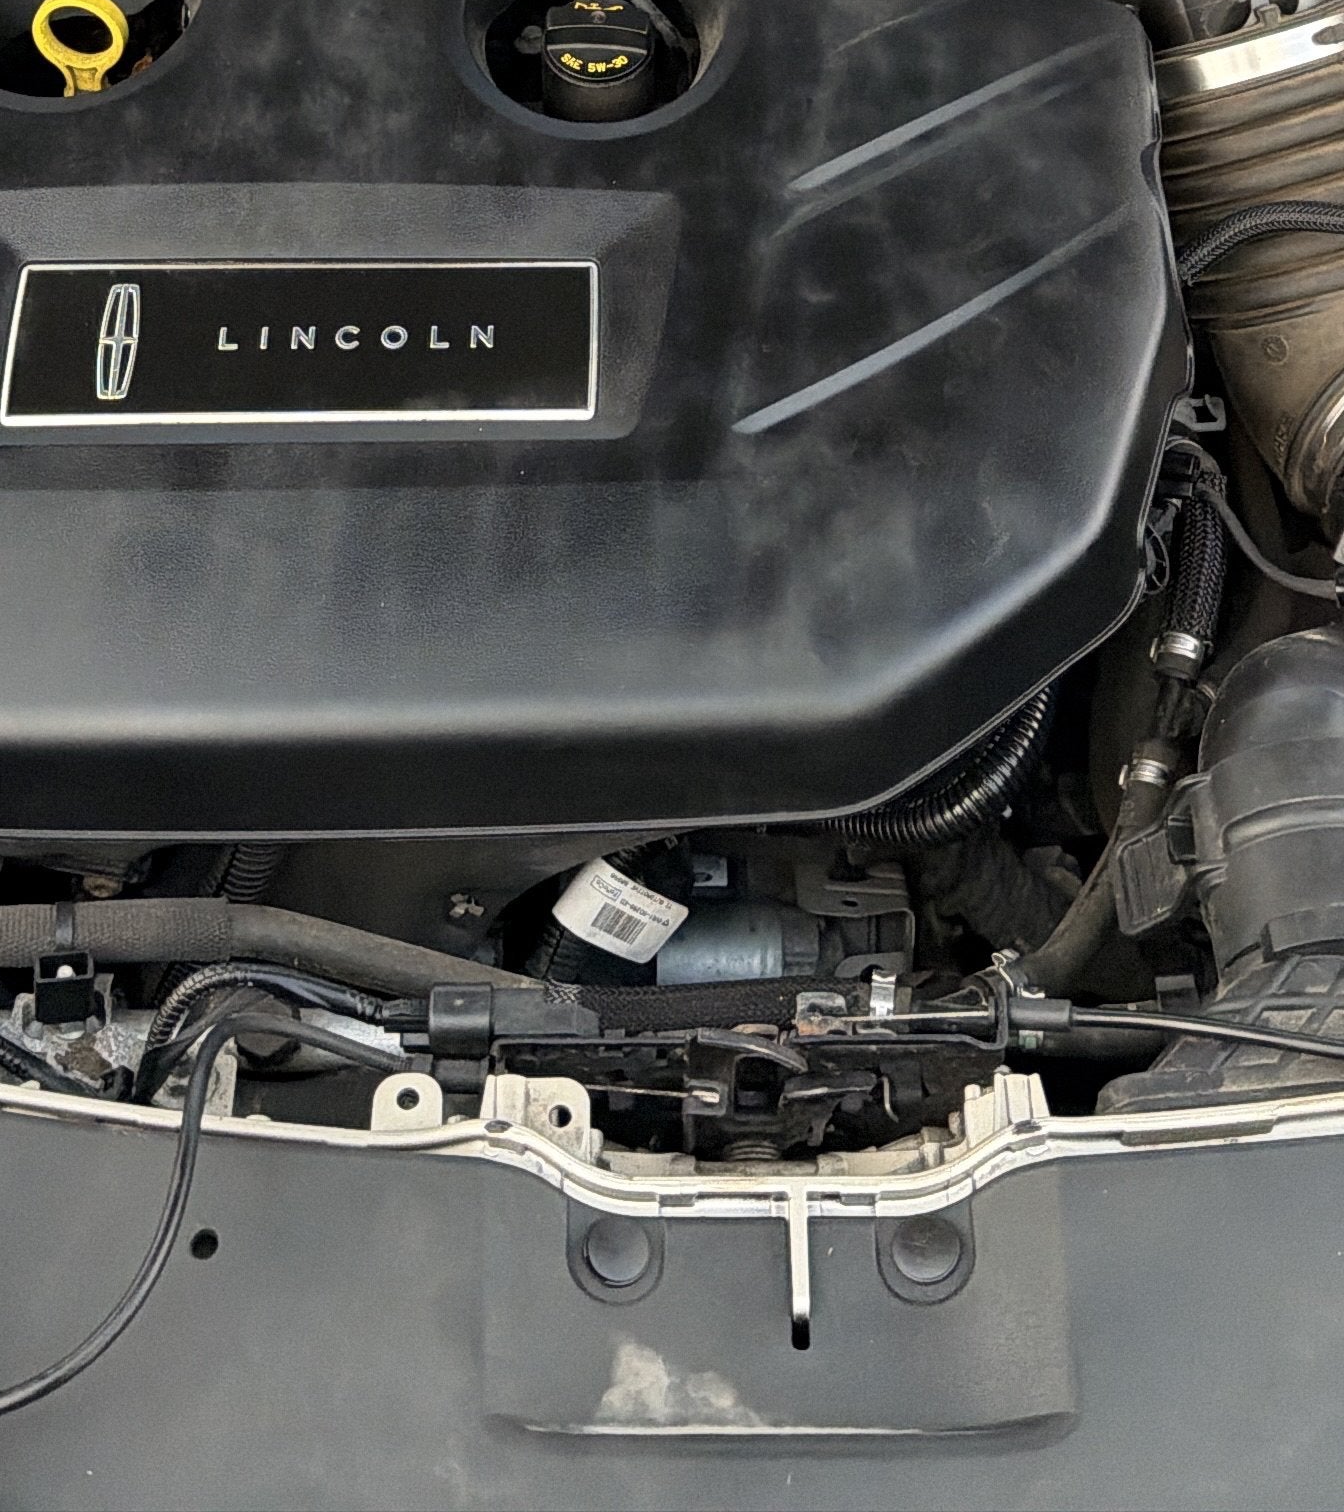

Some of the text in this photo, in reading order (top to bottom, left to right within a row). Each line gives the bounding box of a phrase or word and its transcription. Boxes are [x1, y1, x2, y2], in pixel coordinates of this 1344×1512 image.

[560, 52, 629, 73] SAE 5W-30
[217, 324, 495, 351] LINCOLN
